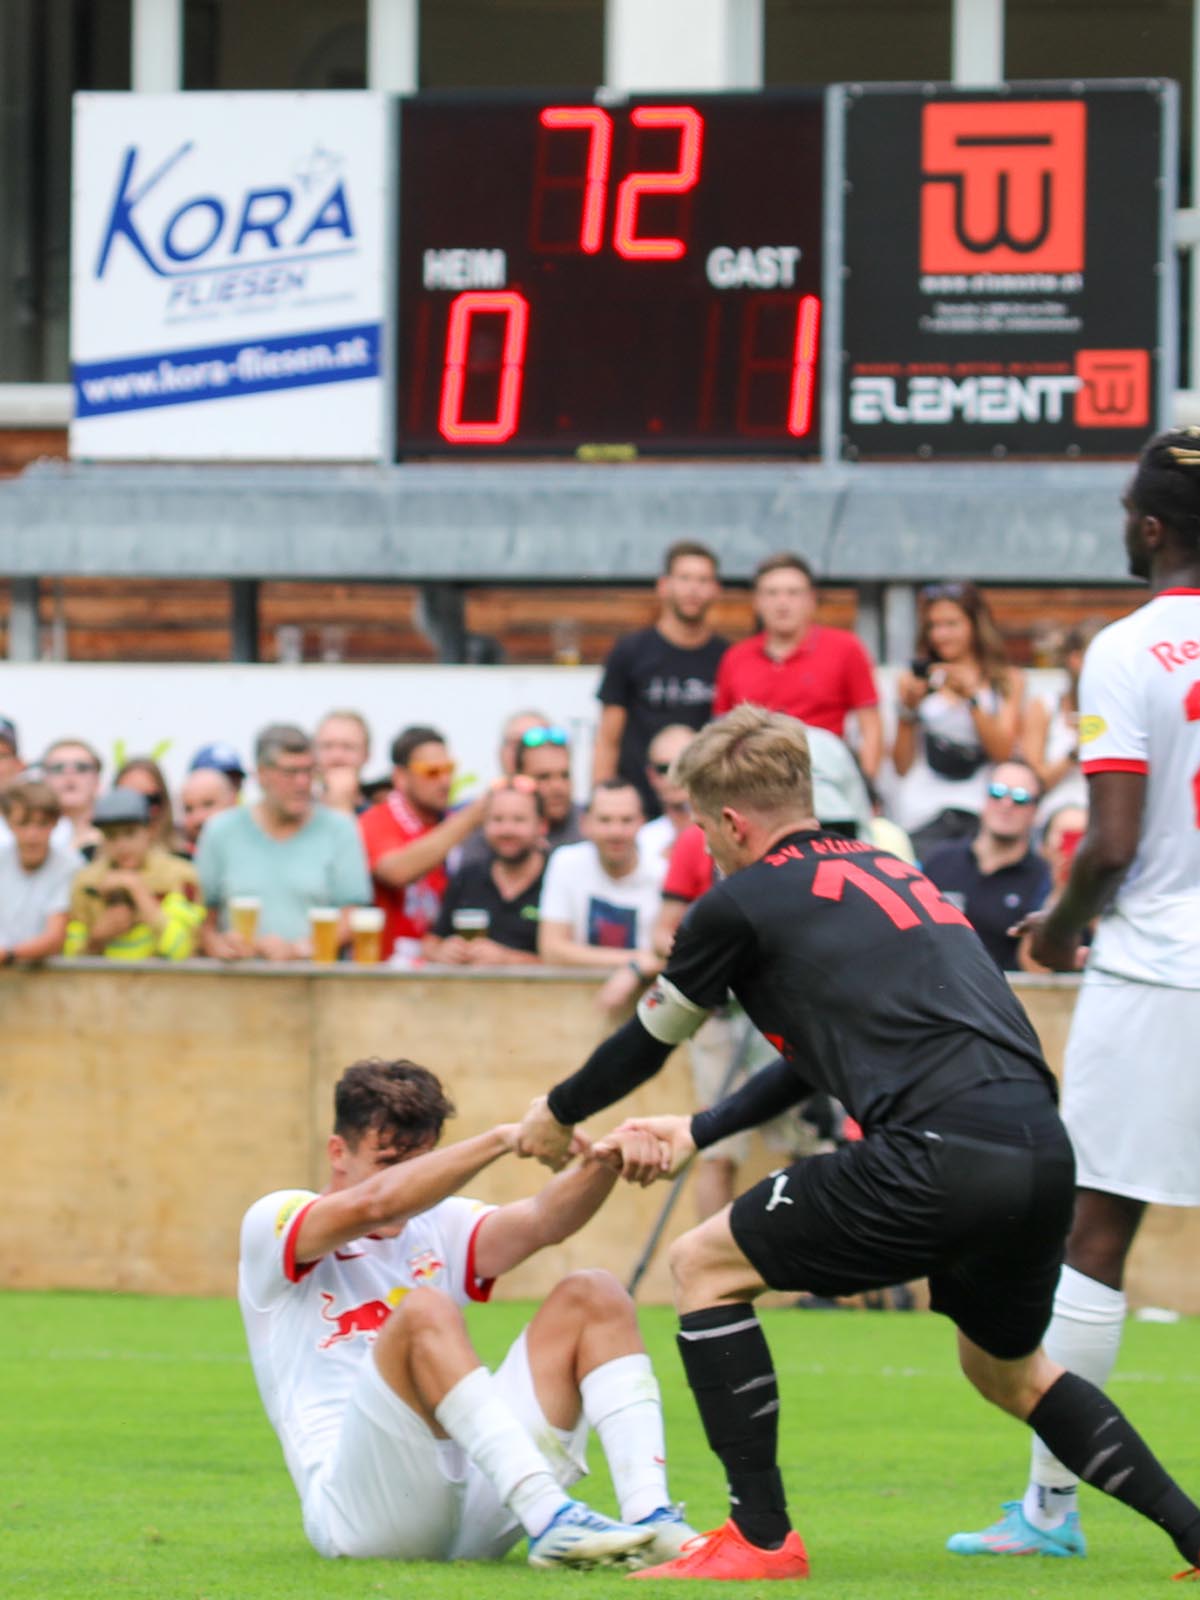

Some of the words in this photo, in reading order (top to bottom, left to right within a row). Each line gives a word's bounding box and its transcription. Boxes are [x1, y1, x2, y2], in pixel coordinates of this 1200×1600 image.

[540, 106, 704, 260] 72
[165, 270, 309, 305] FLIESEN
[423, 248, 507, 290] HEIM
[706, 246, 801, 288] GAST
[82, 336, 369, 404] www.kora-fliesen.at
[438, 291, 529, 444] 0
[787, 294, 821, 437] 1
[851, 375, 1084, 424] ELEMENT
[811, 858, 976, 931] 12
